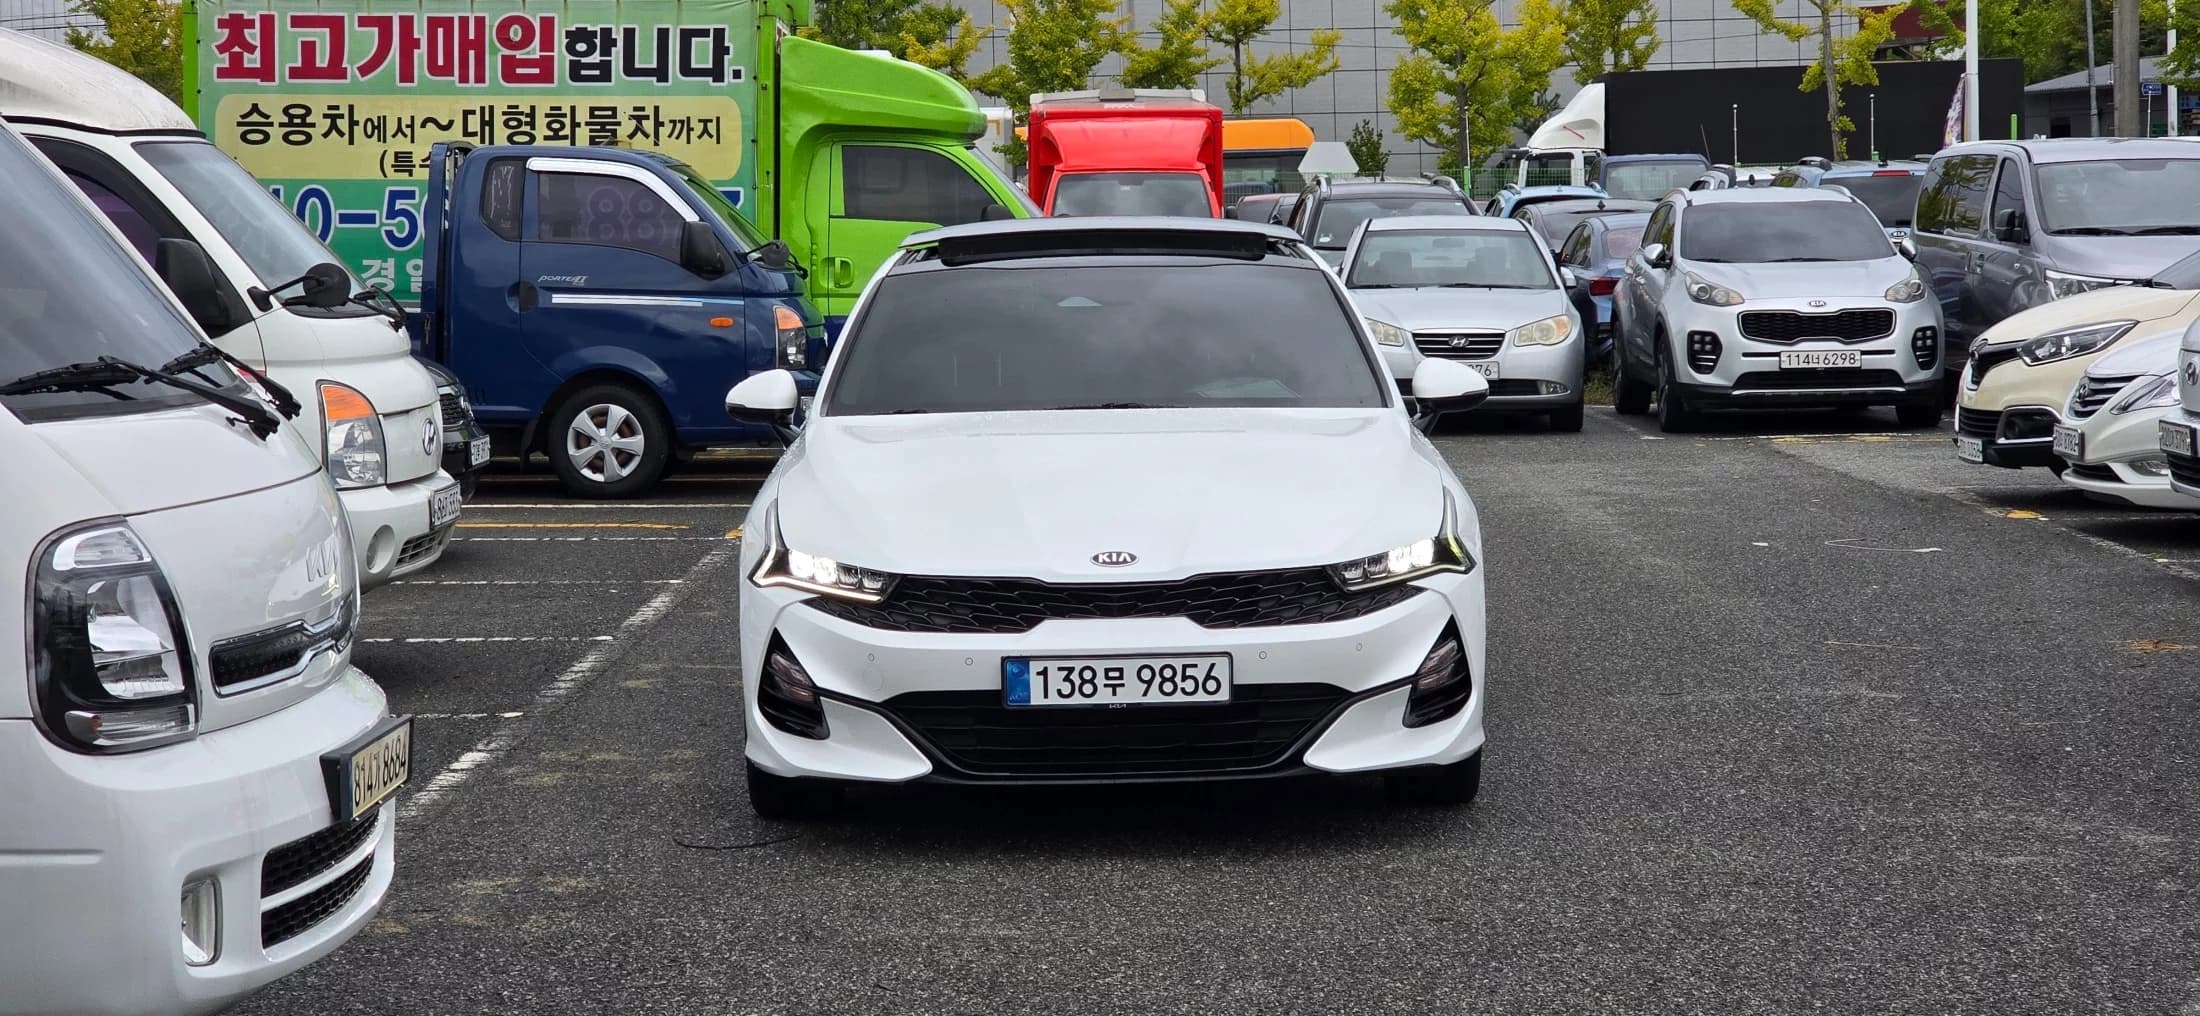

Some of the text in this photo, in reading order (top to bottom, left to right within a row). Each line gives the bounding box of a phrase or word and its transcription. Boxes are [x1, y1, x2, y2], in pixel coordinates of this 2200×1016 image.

[1822, 353, 1857, 366] 6298
[1098, 552, 1132, 563] KIA
[1035, 662, 1222, 699] 138무 9856
[382, 730, 407, 788] 8684
